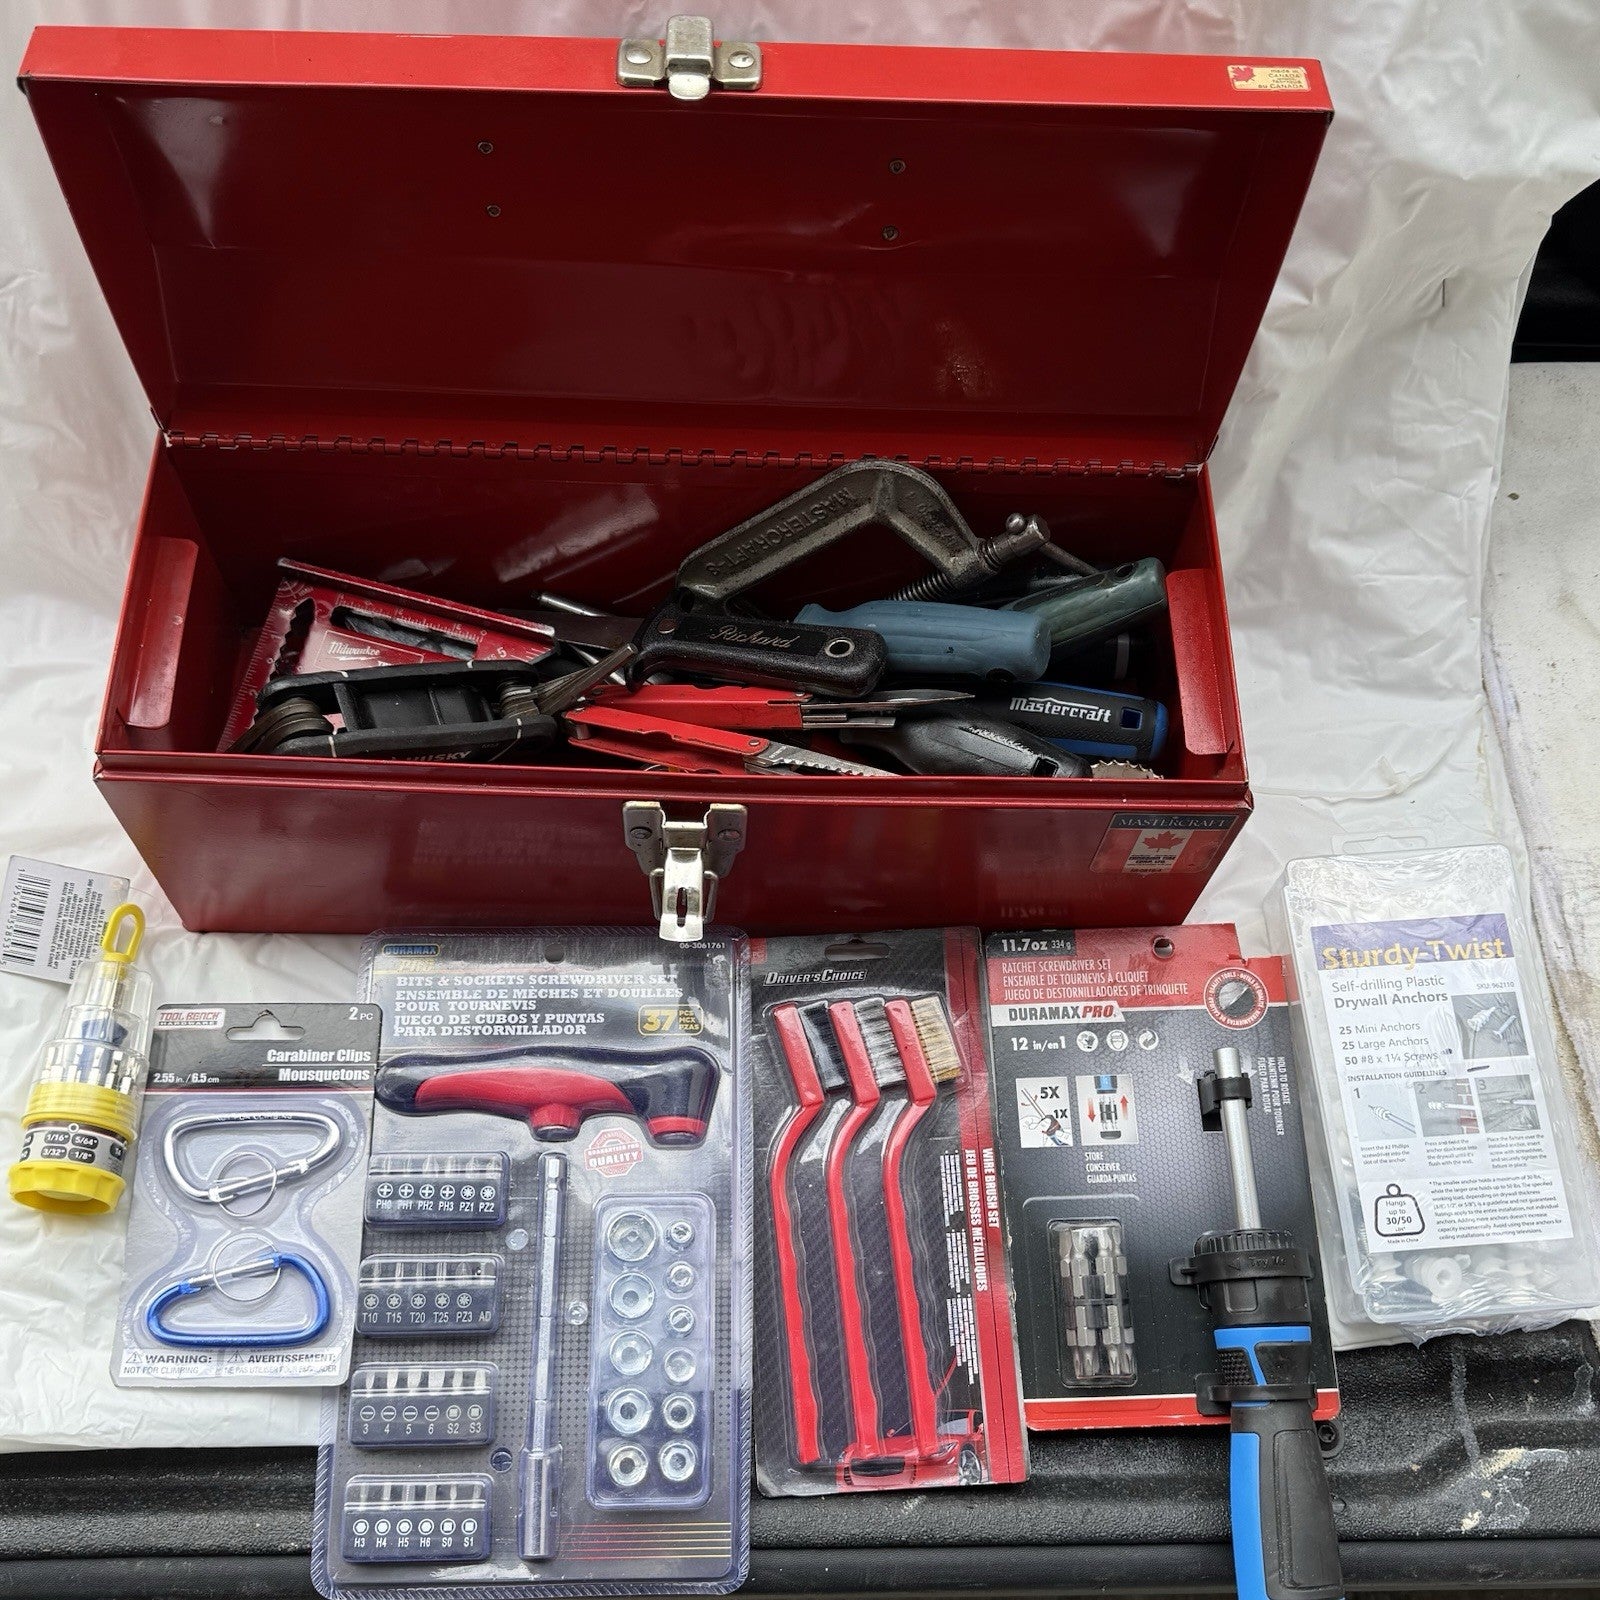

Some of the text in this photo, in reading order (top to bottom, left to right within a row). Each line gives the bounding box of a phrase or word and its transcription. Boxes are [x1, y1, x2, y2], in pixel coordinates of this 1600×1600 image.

[328, 641, 380, 655] Milwaukee
[497, 647, 507, 658] 5
[1009, 697, 1112, 723] Mastercraft
[1118, 818, 1228, 827] MASTERCRAFT
[1322, 937, 1506, 970] Sturdy-Twist
[1002, 958, 1111, 974] RATCHET SCREWDRIVER SET
[396, 974, 678, 987] BITS & SOCKETS SCREWDRIVER SET
[1003, 974, 1044, 987] ENSEMBLE
[1048, 974, 1058, 986] DE
[1061, 972, 1105, 985] TOURNEVIS
[1115, 970, 1149, 983] CLIQUET
[1331, 975, 1445, 993] Self-drilling Plastic
[396, 986, 683, 1000] ENSEMBLE DE MÈCHES ET DOUILLES
[1004, 983, 1188, 1001] JUEGO DE DESTORNILLADORES DE TRINQUETE
[395, 1000, 537, 1012] POUR TOURNEVIS
[1334, 991, 1448, 1010] Drywall Anchors
[160, 1012, 185, 1021] TOOL
[349, 1006, 374, 1021] 2 PC
[393, 1013, 605, 1027] JUEGO DE CUBOS Y PUNTAS
[642, 1009, 678, 1031] 37
[393, 1025, 586, 1037] PARA DESTORNILLADOR
[1339, 1021, 1420, 1035] 25 Mini Anchors
[1010, 1037, 1029, 1051] 12
[1342, 1036, 1429, 1052] 25 Large Anchors
[267, 1049, 371, 1064] Carabiner Clips
[1344, 1056, 1358, 1066] 50
[1361, 1055, 1374, 1064] #8
[1404, 1051, 1439, 1061] Screws
[153, 1073, 175, 1083] 2.55
[191, 1073, 207, 1083] 6.5
[278, 1068, 370, 1083] Mousquetons
[1347, 1069, 1447, 1082] INSTALLATION GUIDELINES
[1040, 1086, 1060, 1099] 5X
[1353, 1080, 1486, 1099] 1 2 3
[1054, 1109, 1068, 1118] 1X
[588, 1151, 639, 1167] QUALITY
[965, 1149, 976, 1165] JEU
[966, 1166, 978, 1179] DE
[982, 1148, 1000, 1228] WIRE BRUSH SET
[418, 1200, 433, 1210] PH2
[438, 1201, 454, 1211] PH3
[459, 1202, 474, 1212] PZ1
[479, 1202, 495, 1212] PZ2
[967, 1181, 982, 1226] BROSSES
[1386, 1216, 1412, 1225] 30/50
[362, 1312, 378, 1323] T10
[386, 1312, 402, 1323] T15
[410, 1312, 426, 1323] T20
[433, 1311, 449, 1322] T25
[456, 1311, 472, 1322] PZ3
[146, 1354, 212, 1364] WARNING:
[123, 1366, 141, 1374] NOT
[142, 1366, 159, 1374] FOR
[363, 1422, 482, 1434] 3 4 5 6 S2 S3
[354, 1537, 365, 1548] H3
[376, 1537, 387, 1548] H4
[398, 1537, 409, 1547] H5
[463, 1537, 474, 1547] S1
